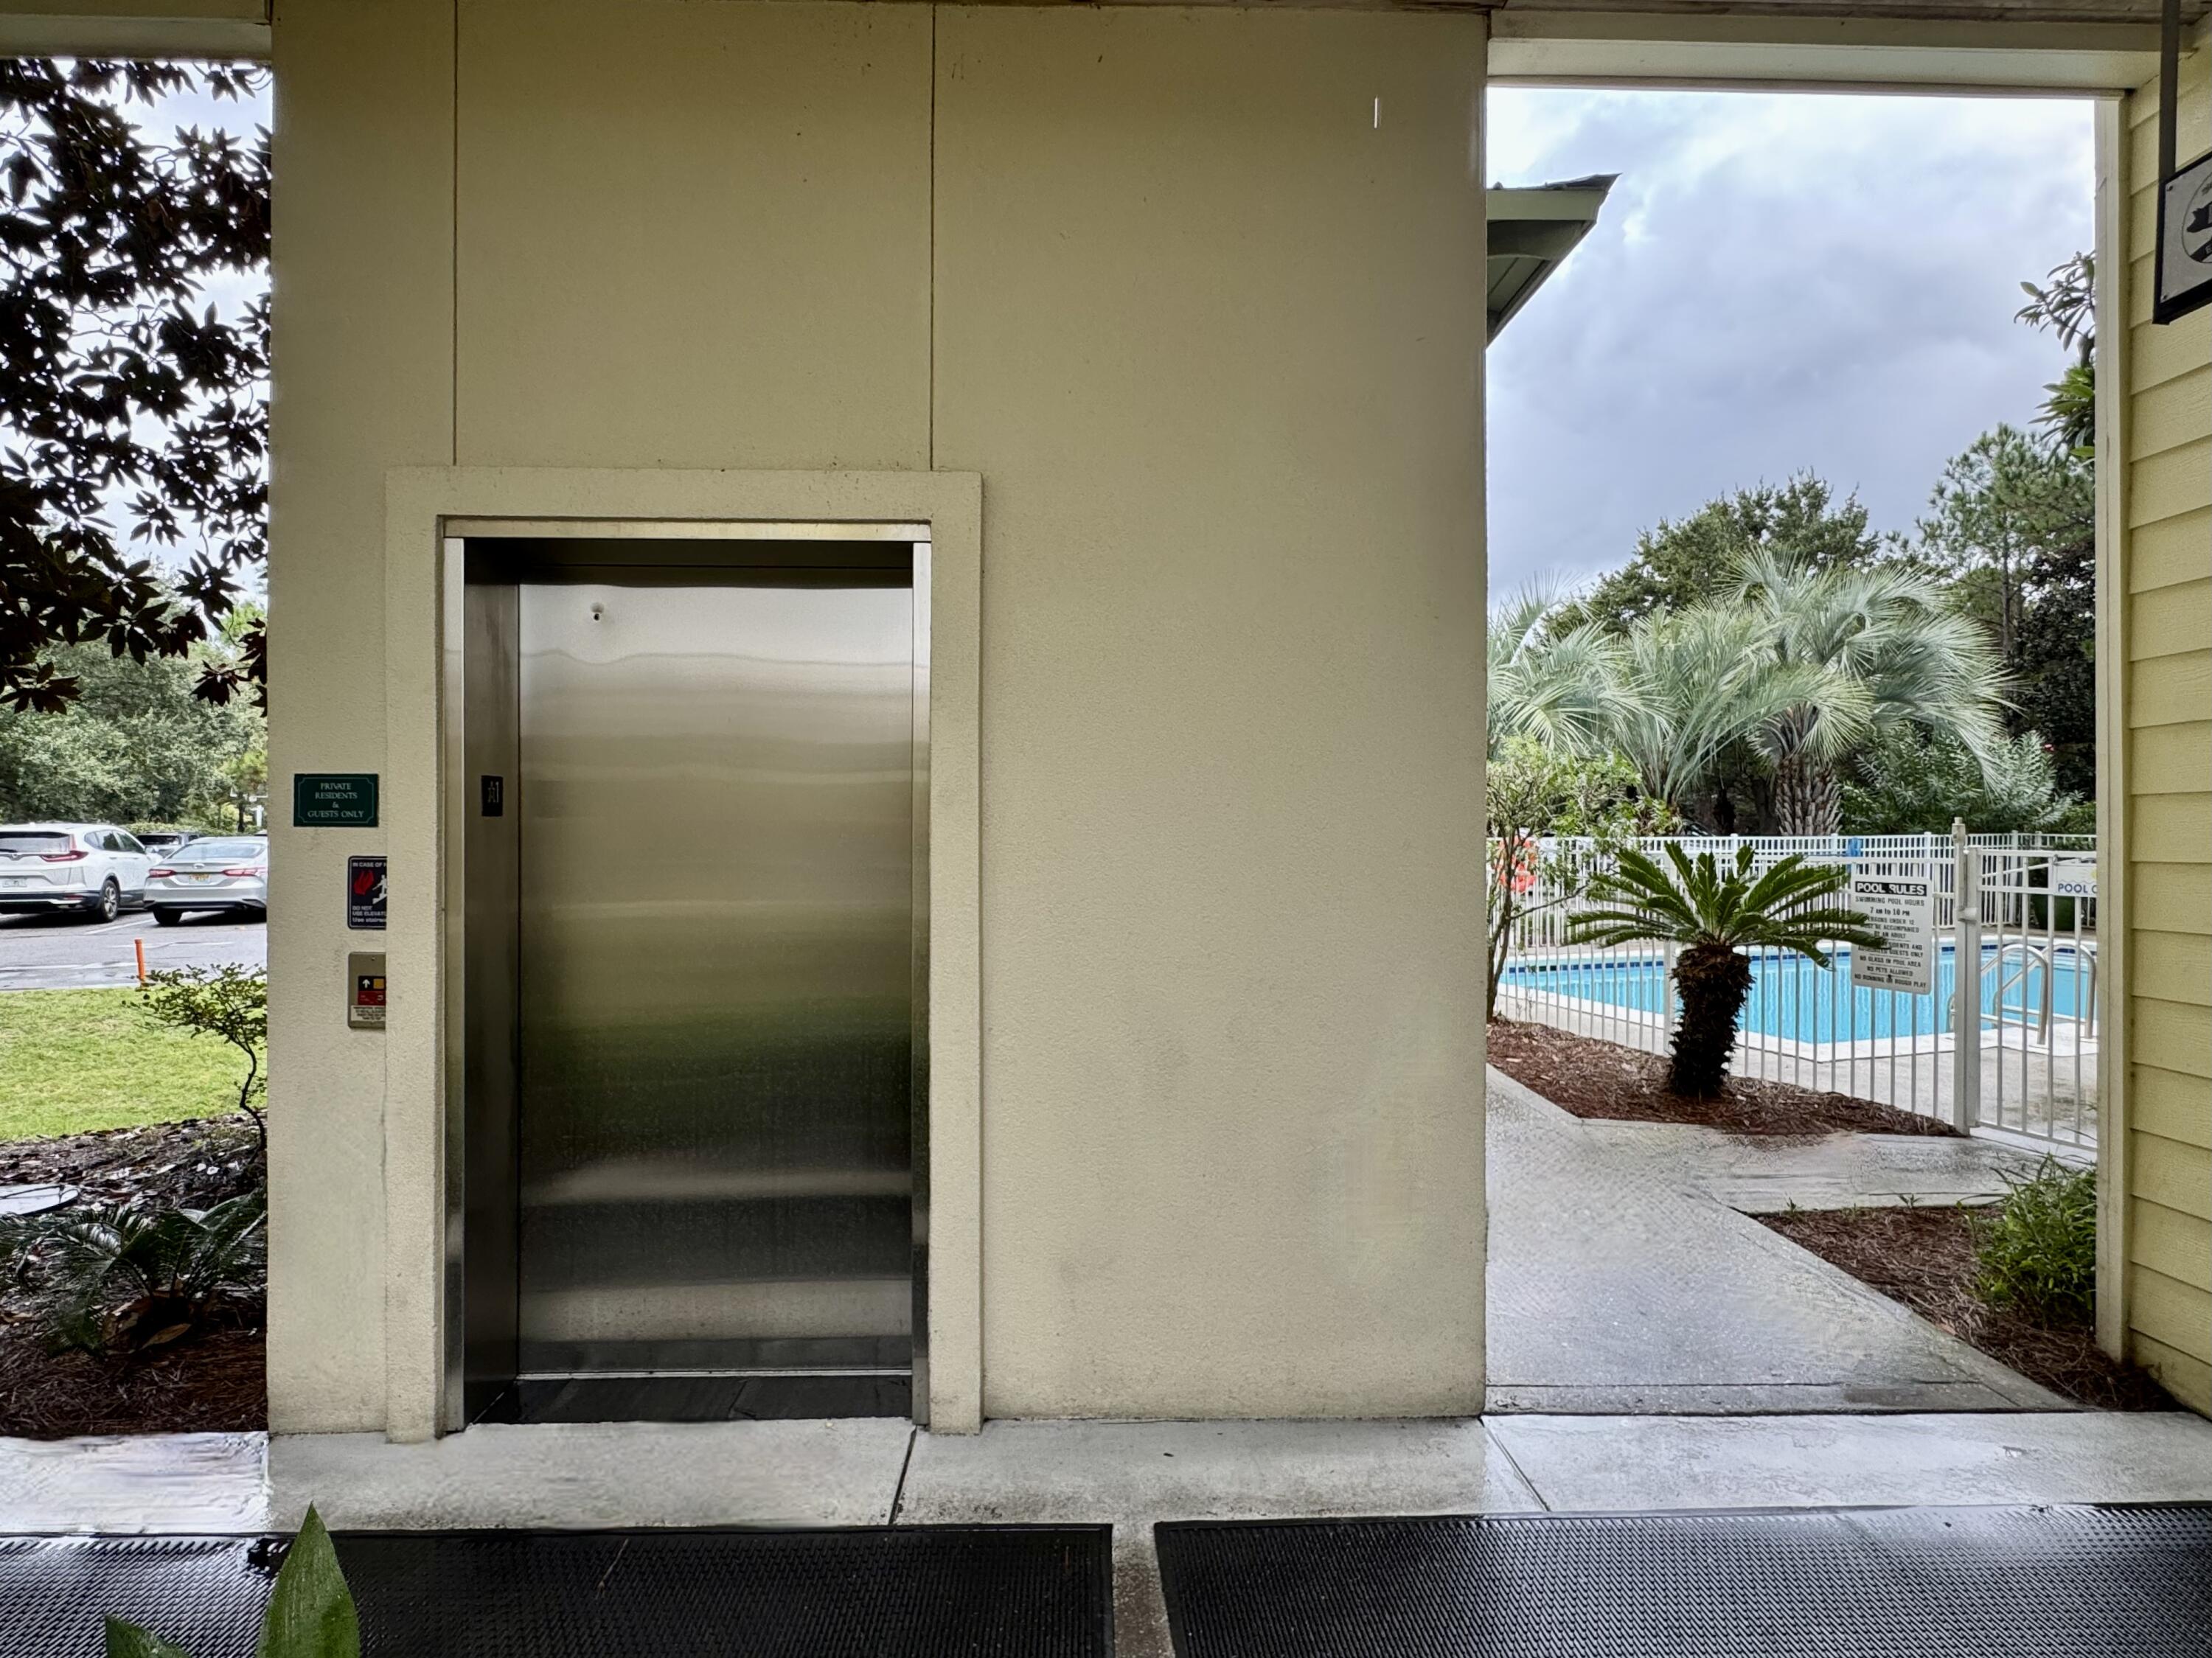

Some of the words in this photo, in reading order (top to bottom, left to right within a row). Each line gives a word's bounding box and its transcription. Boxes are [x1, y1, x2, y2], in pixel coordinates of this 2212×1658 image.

[320, 782, 352, 790] PRIVATE
[1857, 882, 1885, 893] POOL
[1888, 884, 1925, 895] RULES
[2058, 883, 2088, 893] POOL
[1855, 896, 1885, 904] SWIMMING
